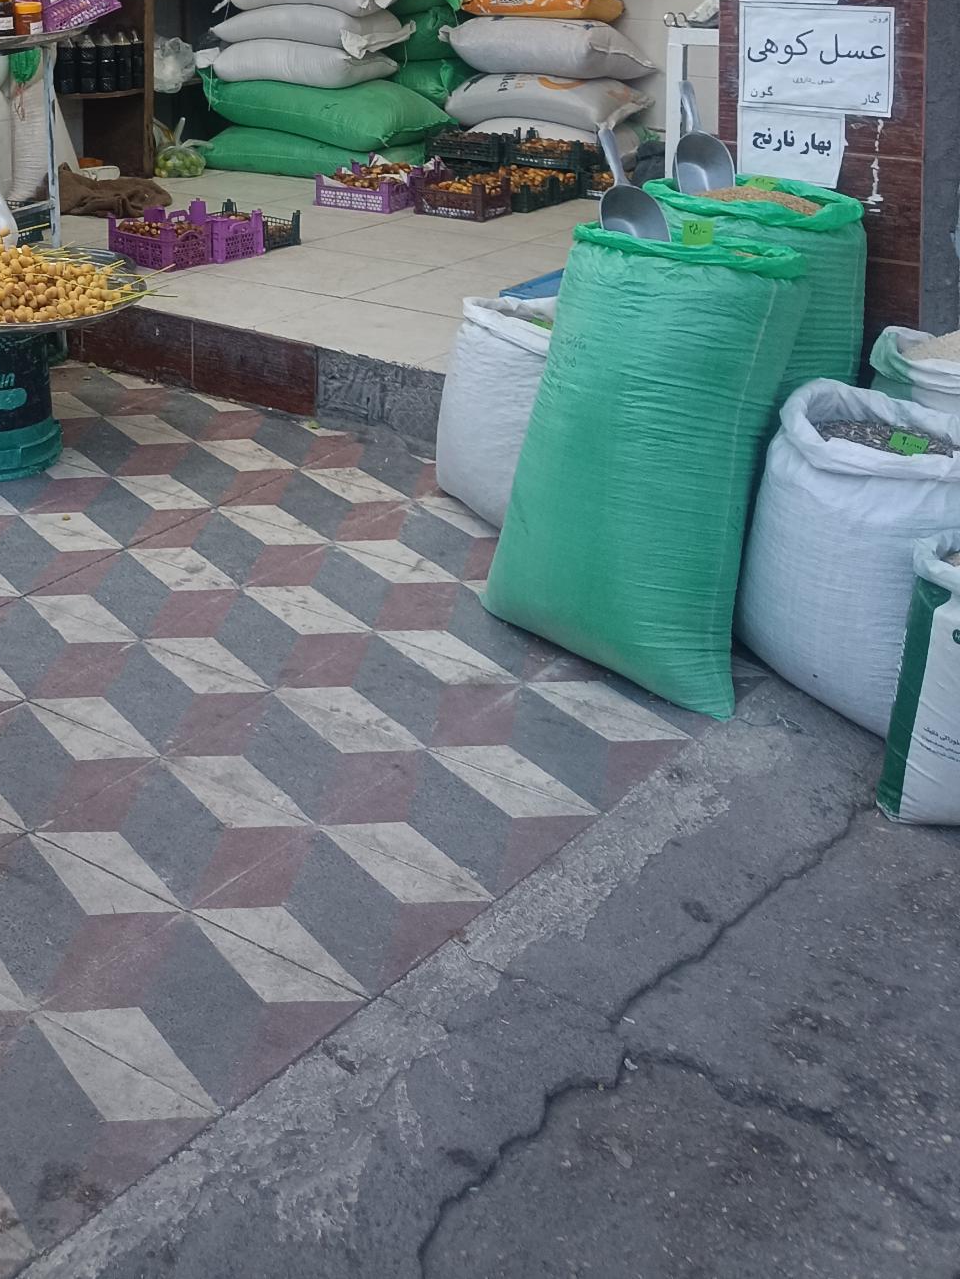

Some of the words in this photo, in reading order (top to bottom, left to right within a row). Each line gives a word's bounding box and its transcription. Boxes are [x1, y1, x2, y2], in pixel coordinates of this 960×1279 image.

[747, 29, 814, 65] کوهی
[819, 33, 886, 65] عسل
[750, 85, 774, 98] گون
[752, 127, 795, 152] نارنج
[800, 132, 832, 156] بهار
